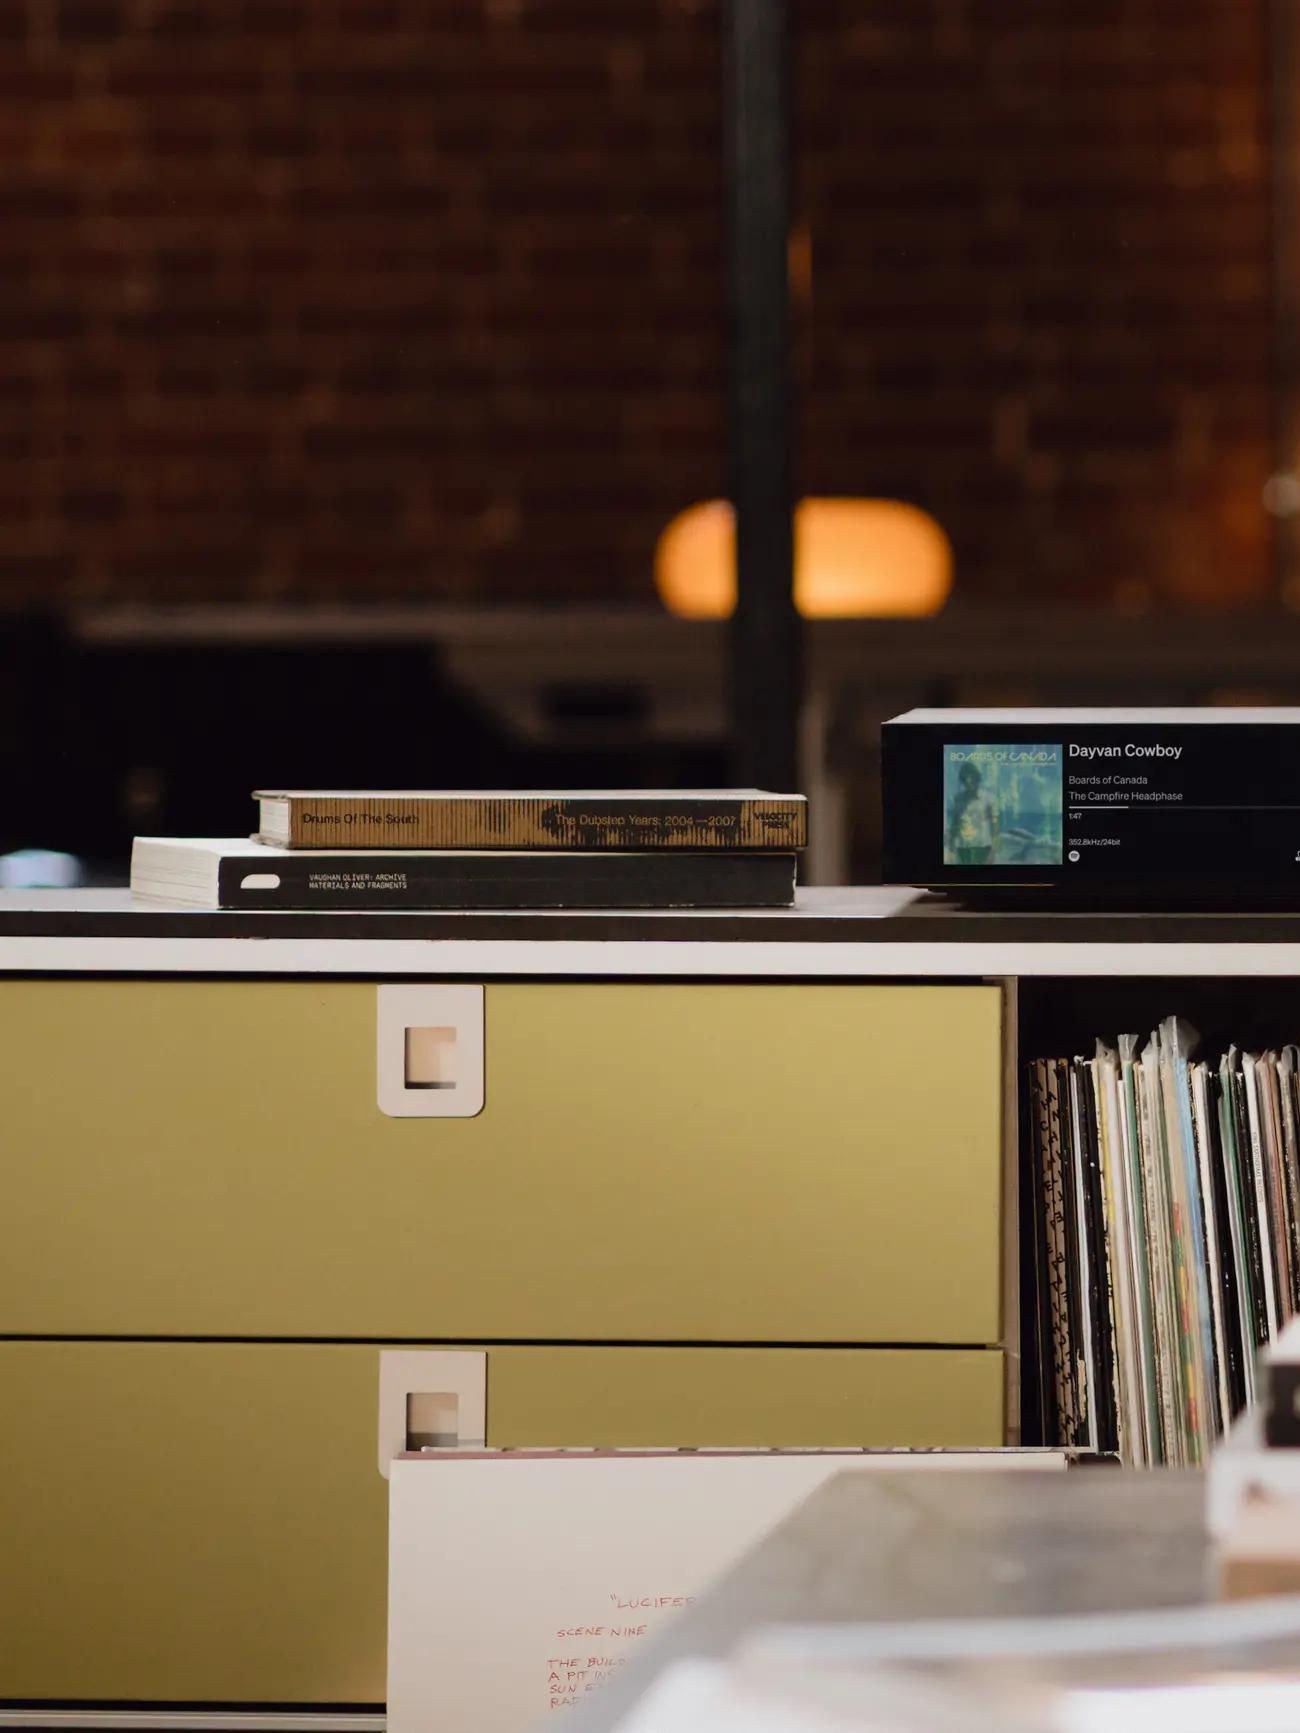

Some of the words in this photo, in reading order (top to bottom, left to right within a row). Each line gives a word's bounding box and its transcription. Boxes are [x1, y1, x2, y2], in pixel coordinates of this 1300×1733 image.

[950, 752, 993, 761] BOARDS
[994, 752, 1007, 761] OF
[1009, 752, 1057, 761] CANADA
[1069, 744, 1121, 760] Dayvan
[1125, 744, 1182, 760] Cowboy
[1069, 775, 1100, 784] Boards
[1103, 775, 1112, 784] of
[1113, 775, 1148, 784] Canada
[1069, 791, 1086, 800] The
[1088, 791, 1129, 802] Campfire
[1131, 791, 1183, 802] Headphase
[303, 813, 340, 824] Drums
[344, 813, 357, 824] Of
[361, 813, 382, 824] The
[386, 813, 419, 824] South
[555, 813, 576, 825] The
[580, 813, 625, 827] Dubstep
[556, 1626, 605, 1638] SCENE
[610, 1624, 648, 1638] NINE
[547, 1658, 581, 1669] THE
[548, 1671, 560, 1683] A
[567, 1670, 588, 1681] PIT
[549, 1684, 577, 1694] SUN
